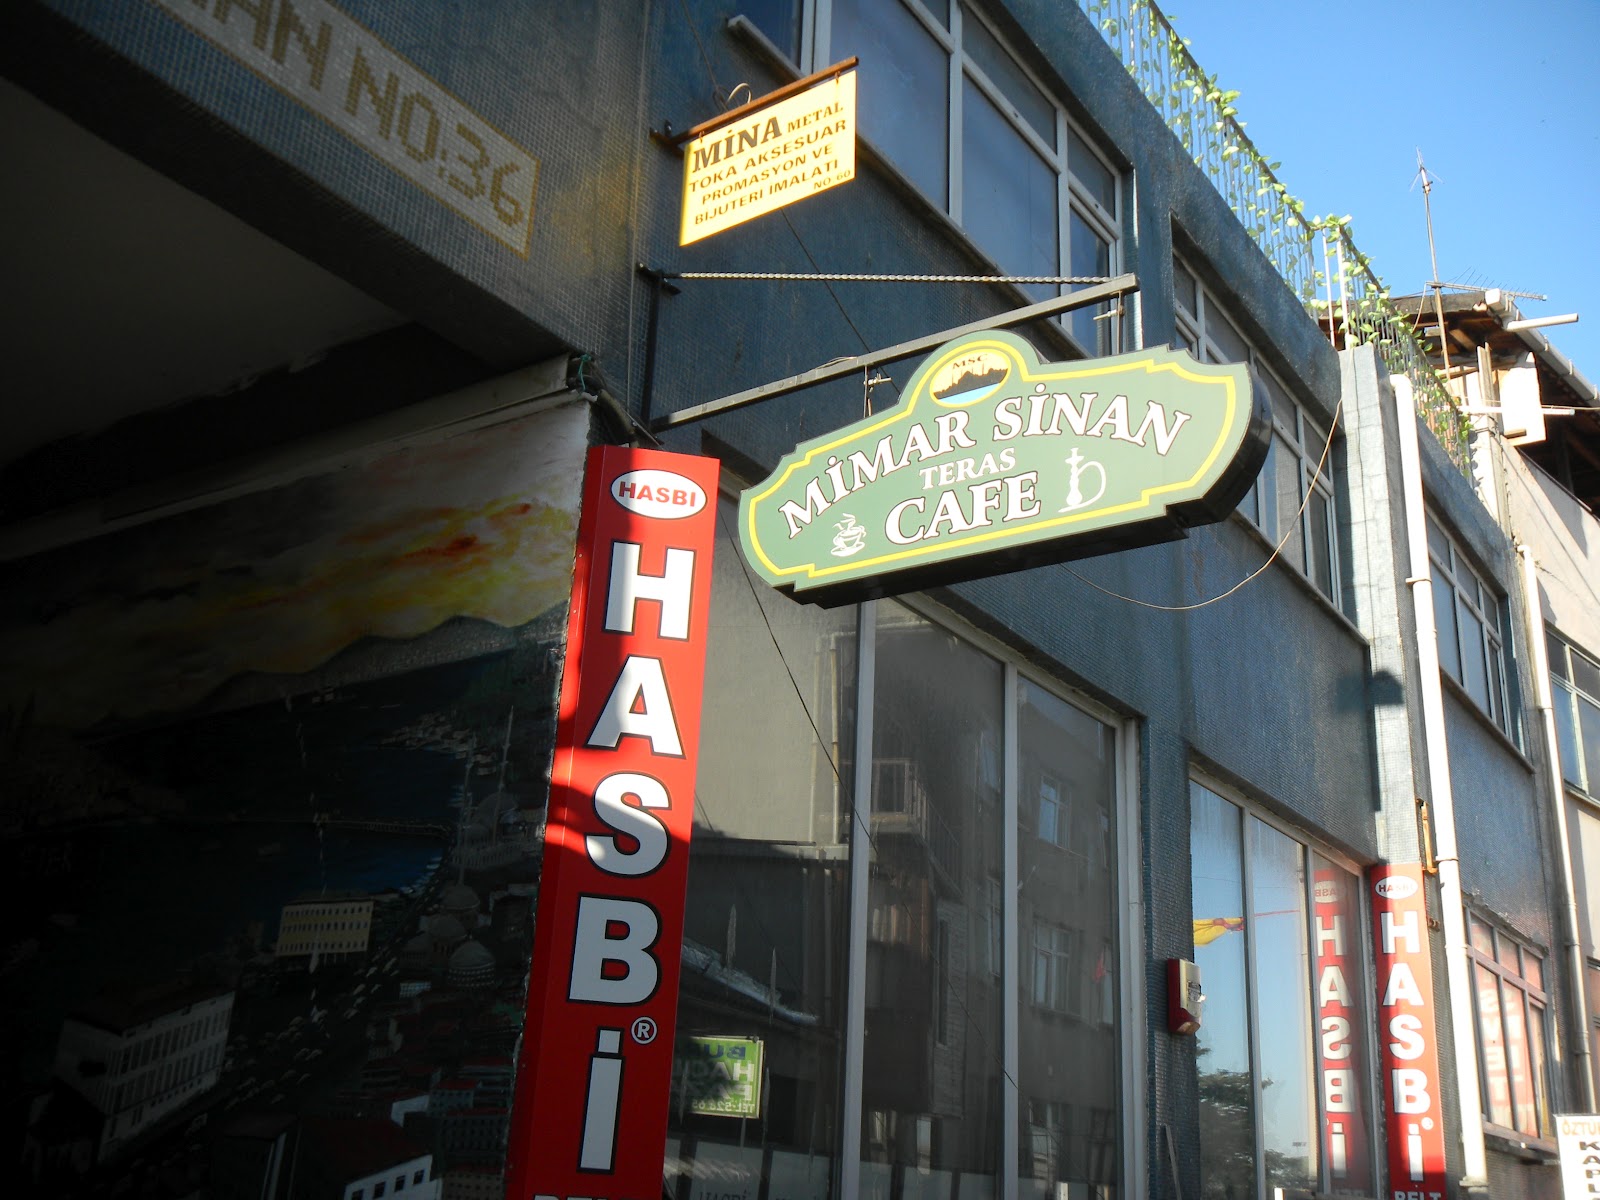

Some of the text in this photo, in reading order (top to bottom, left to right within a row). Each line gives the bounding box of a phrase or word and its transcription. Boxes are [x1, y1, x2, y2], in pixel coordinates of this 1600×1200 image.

[192, 0, 333, 91] AN
[689, 119, 847, 193] TOKA AKSESUAR
[691, 102, 844, 174] MİNA METAL
[702, 143, 833, 206] PROMASYON VE
[814, 176, 832, 190] NO
[619, 480, 697, 507] HASBI
[778, 382, 1192, 540] MİMAR SİNAN
[918, 446, 1018, 491] TERAS
[884, 470, 1042, 548] CAFE
[1561, 1118, 1600, 1136] ÖZTÜ
